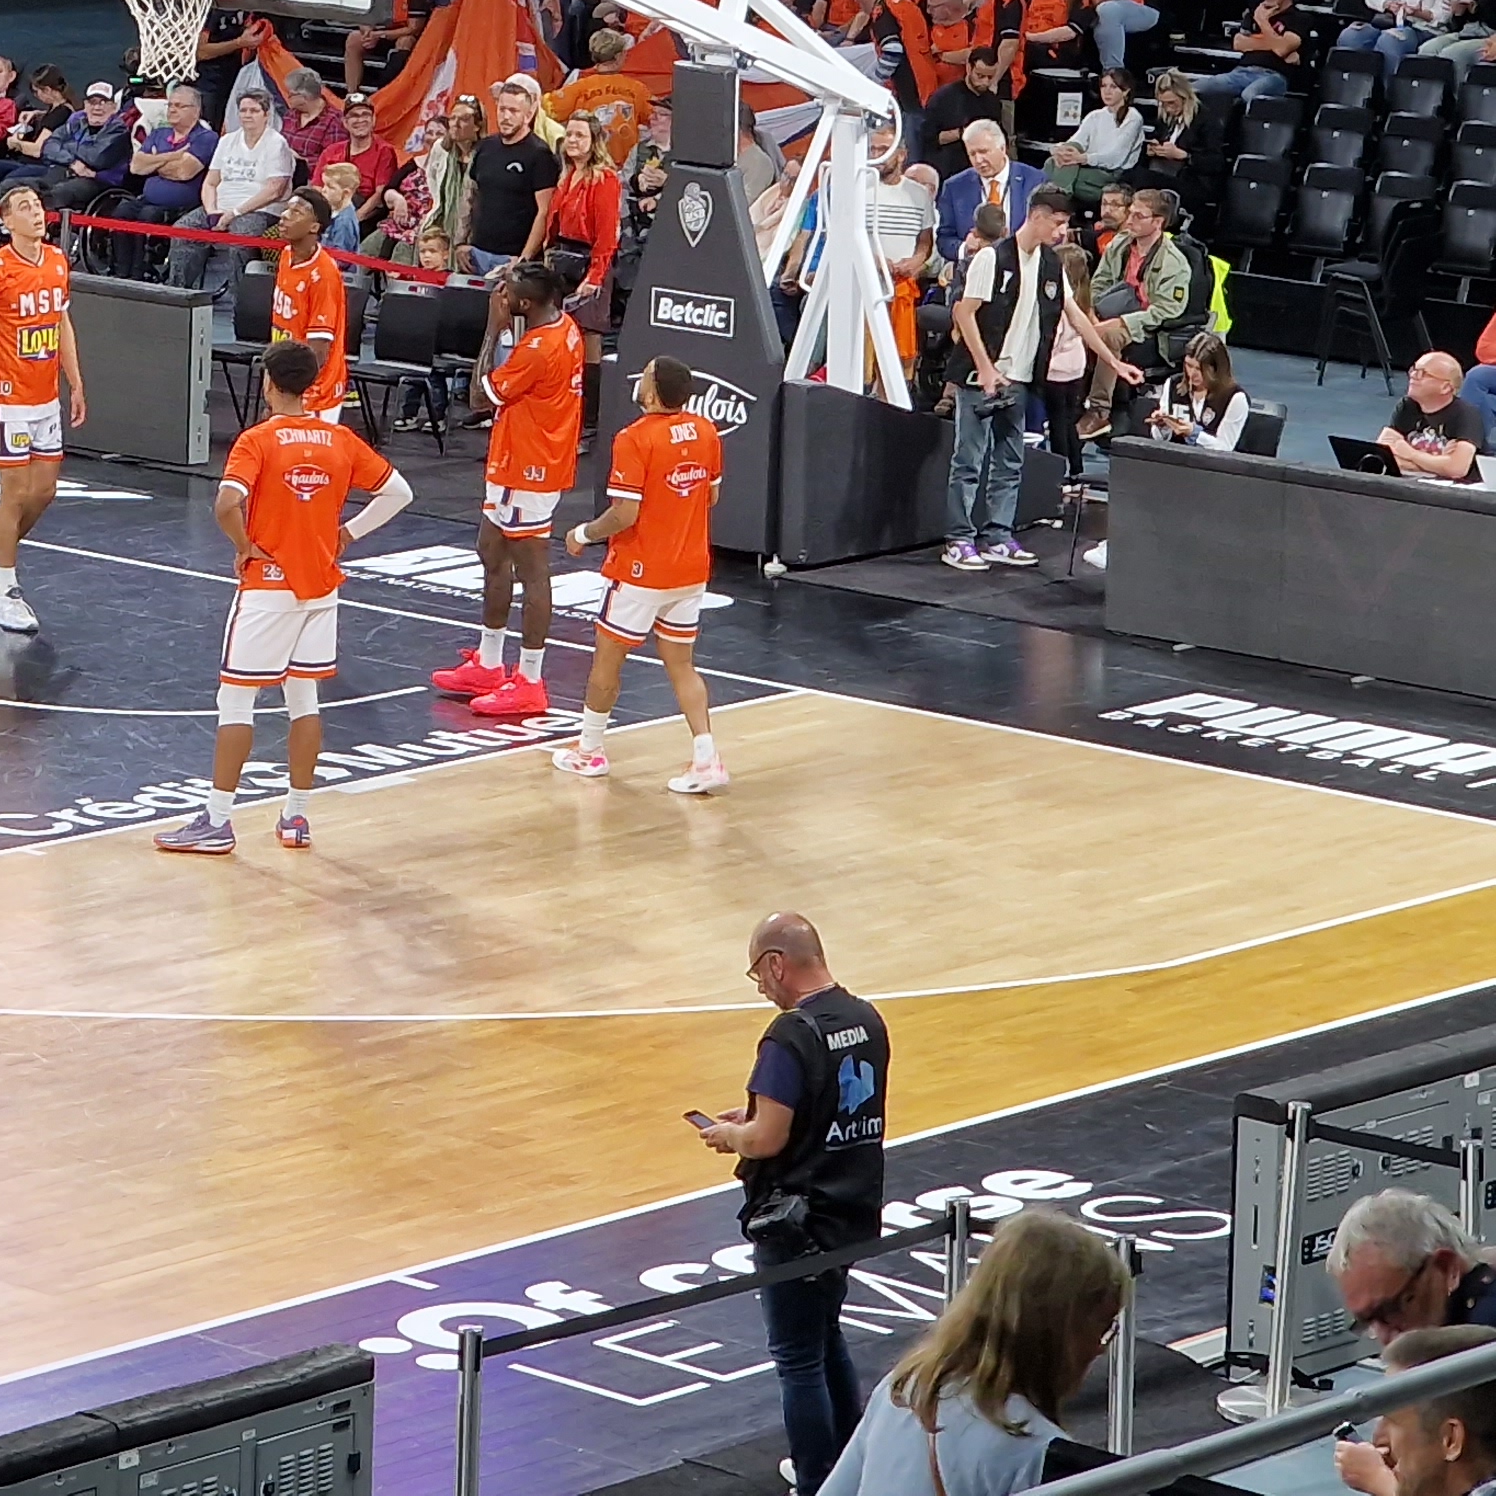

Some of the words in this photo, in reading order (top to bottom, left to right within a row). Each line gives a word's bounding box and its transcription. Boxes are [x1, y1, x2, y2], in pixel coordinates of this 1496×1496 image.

[18, 288, 63, 317] MSB
[656, 297, 728, 329] Betclic
[632, 379, 748, 425] ulois
[669, 422, 698, 444] JONES
[631, 560, 644, 578] 3
[1097, 709, 1444, 783] BASKETBALL
[826, 1025, 870, 1052] MEDIA
